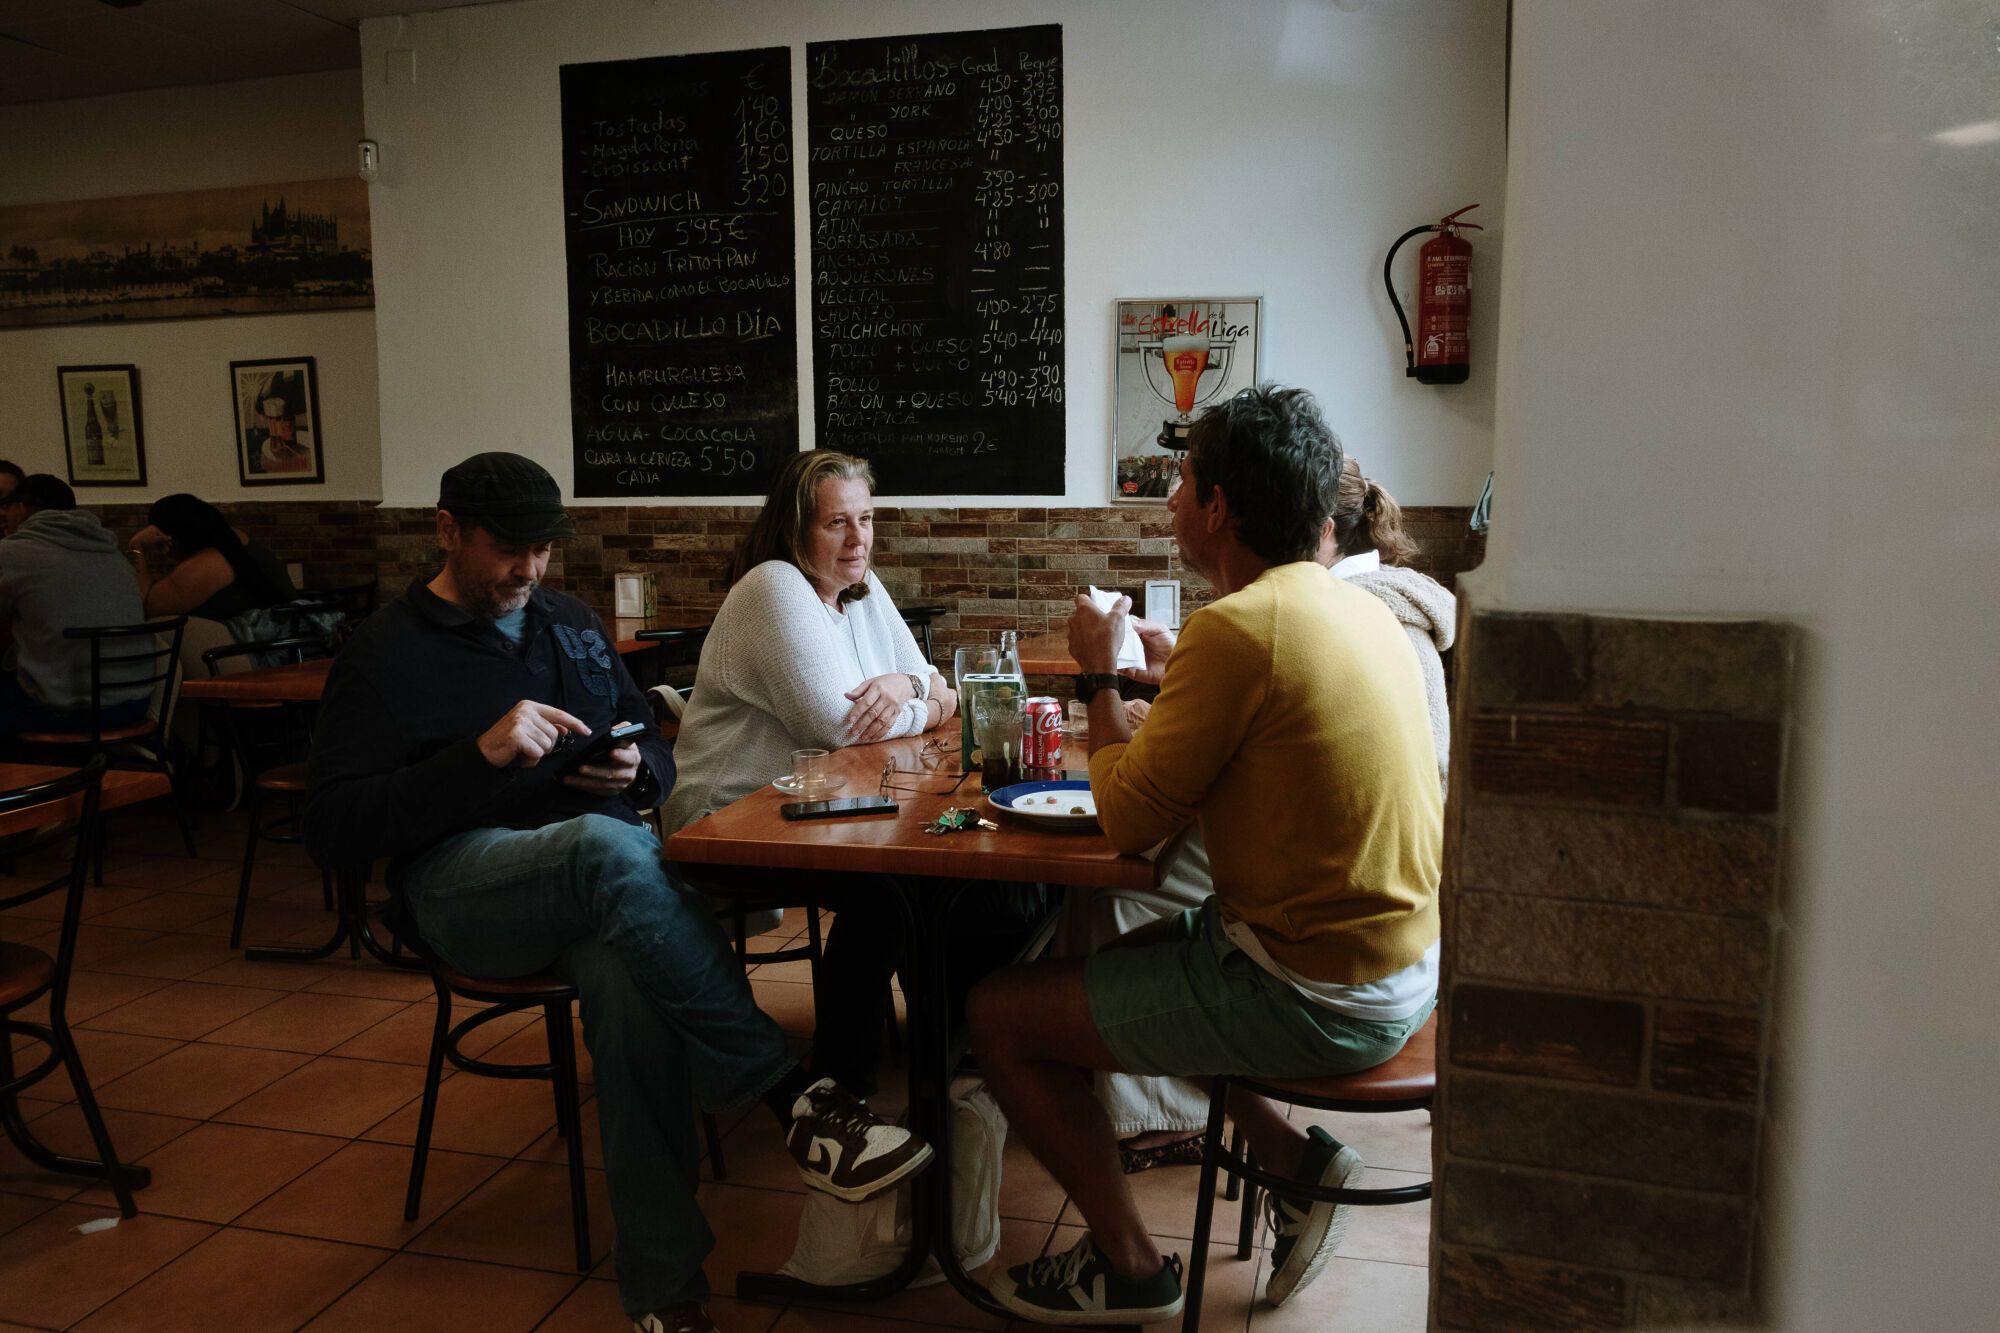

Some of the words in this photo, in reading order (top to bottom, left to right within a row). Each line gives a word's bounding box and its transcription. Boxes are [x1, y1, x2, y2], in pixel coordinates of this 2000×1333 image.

[888, 82, 957, 100] SERRANO
[889, 104, 932, 120] YORK
[591, 110, 687, 137] Tostadas
[830, 124, 888, 141] QUESO
[811, 143, 887, 163] TORTILLA
[814, 181, 869, 199] PINCHO
[883, 176, 954, 191] TORTILLA
[583, 188, 701, 224] SANDWICH
[619, 226, 656, 247] HOY
[817, 217, 862, 235] ATUN
[714, 272, 789, 293] BOCADILLO
[817, 267, 936, 286] BOQUERONES
[585, 314, 726, 344] BOCADILLO
[818, 323, 923, 340] SALCHICHON
[1139, 310, 1210, 337] Estrella
[1212, 320, 1249, 343] Liga
[830, 343, 881, 359] POLLO
[910, 337, 974, 356] QUESO
[605, 362, 747, 387] HAMBURGUESA
[828, 376, 880, 393] POLLO
[601, 393, 640, 413] CON
[650, 391, 727, 413] QUESO
[826, 394, 885, 410] BACON
[910, 391, 974, 409] QUESO
